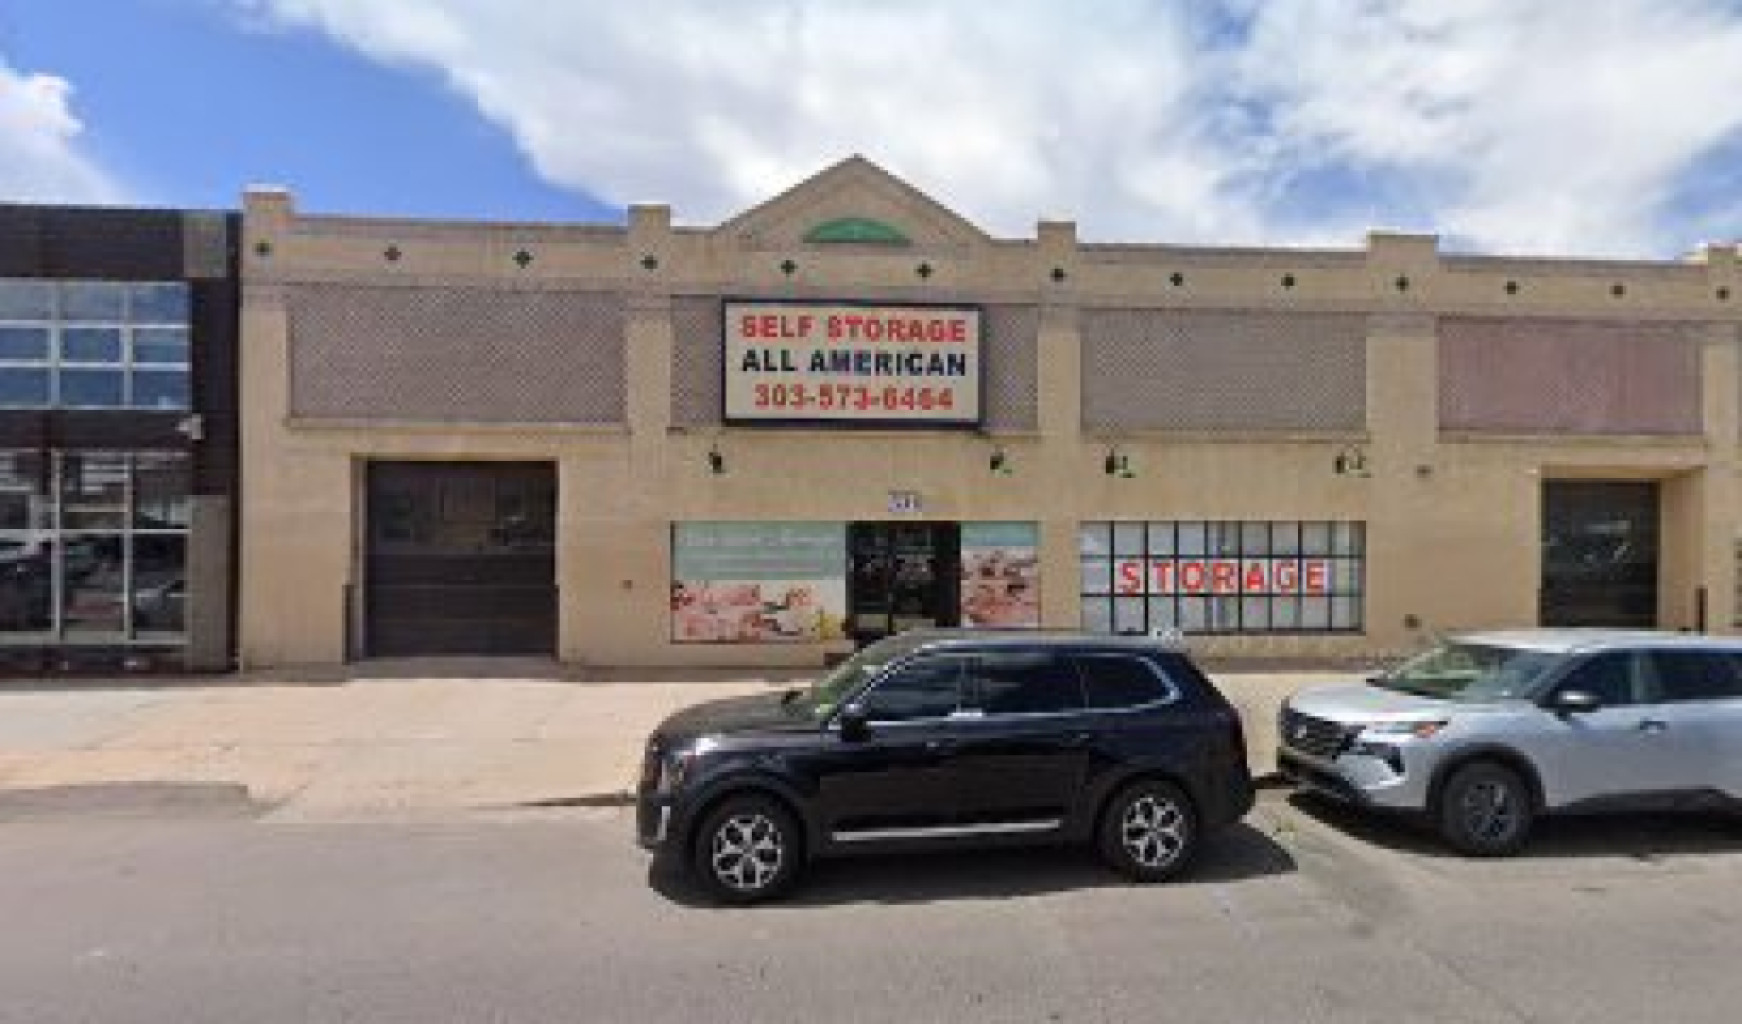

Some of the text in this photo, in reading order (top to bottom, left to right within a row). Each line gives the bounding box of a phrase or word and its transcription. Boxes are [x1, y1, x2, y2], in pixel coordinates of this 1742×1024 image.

[741, 315, 966, 342] SELF STORAGE
[741, 350, 966, 376] ALL AMERICAN
[1118, 561, 1326, 596] STORAGE
